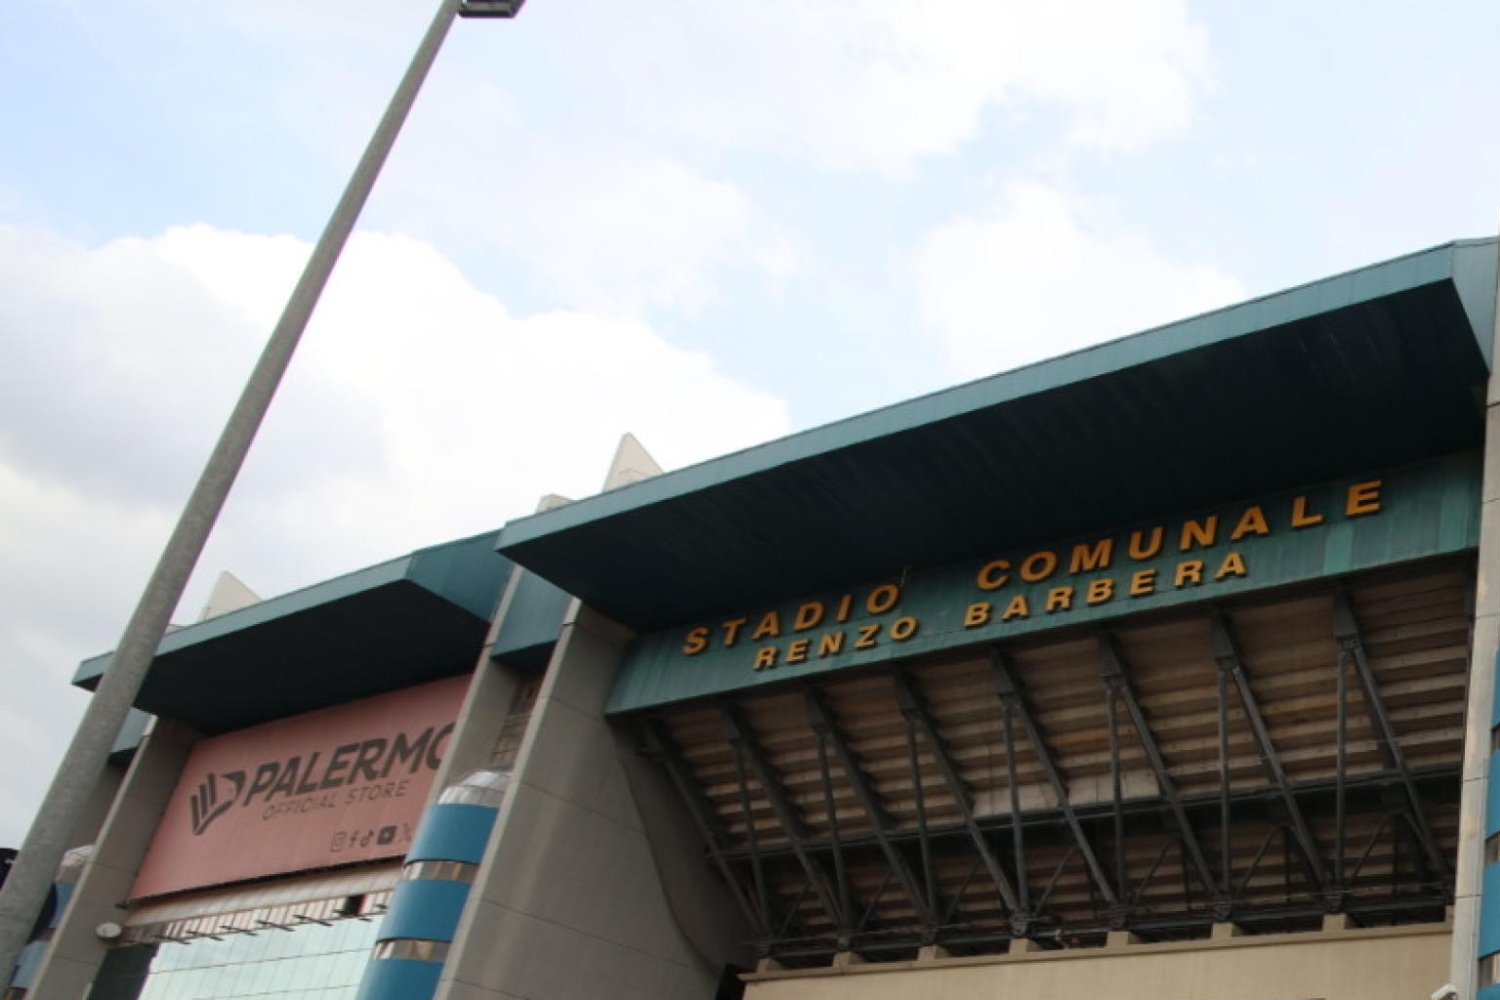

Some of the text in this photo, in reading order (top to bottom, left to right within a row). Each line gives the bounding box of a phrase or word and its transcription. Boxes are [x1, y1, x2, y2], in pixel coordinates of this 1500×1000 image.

[682, 480, 1383, 655] STADIO COMUNALE
[753, 551, 1248, 671] RENZO BARBERA
[261, 780, 409, 821] OFFICIAL STORE
